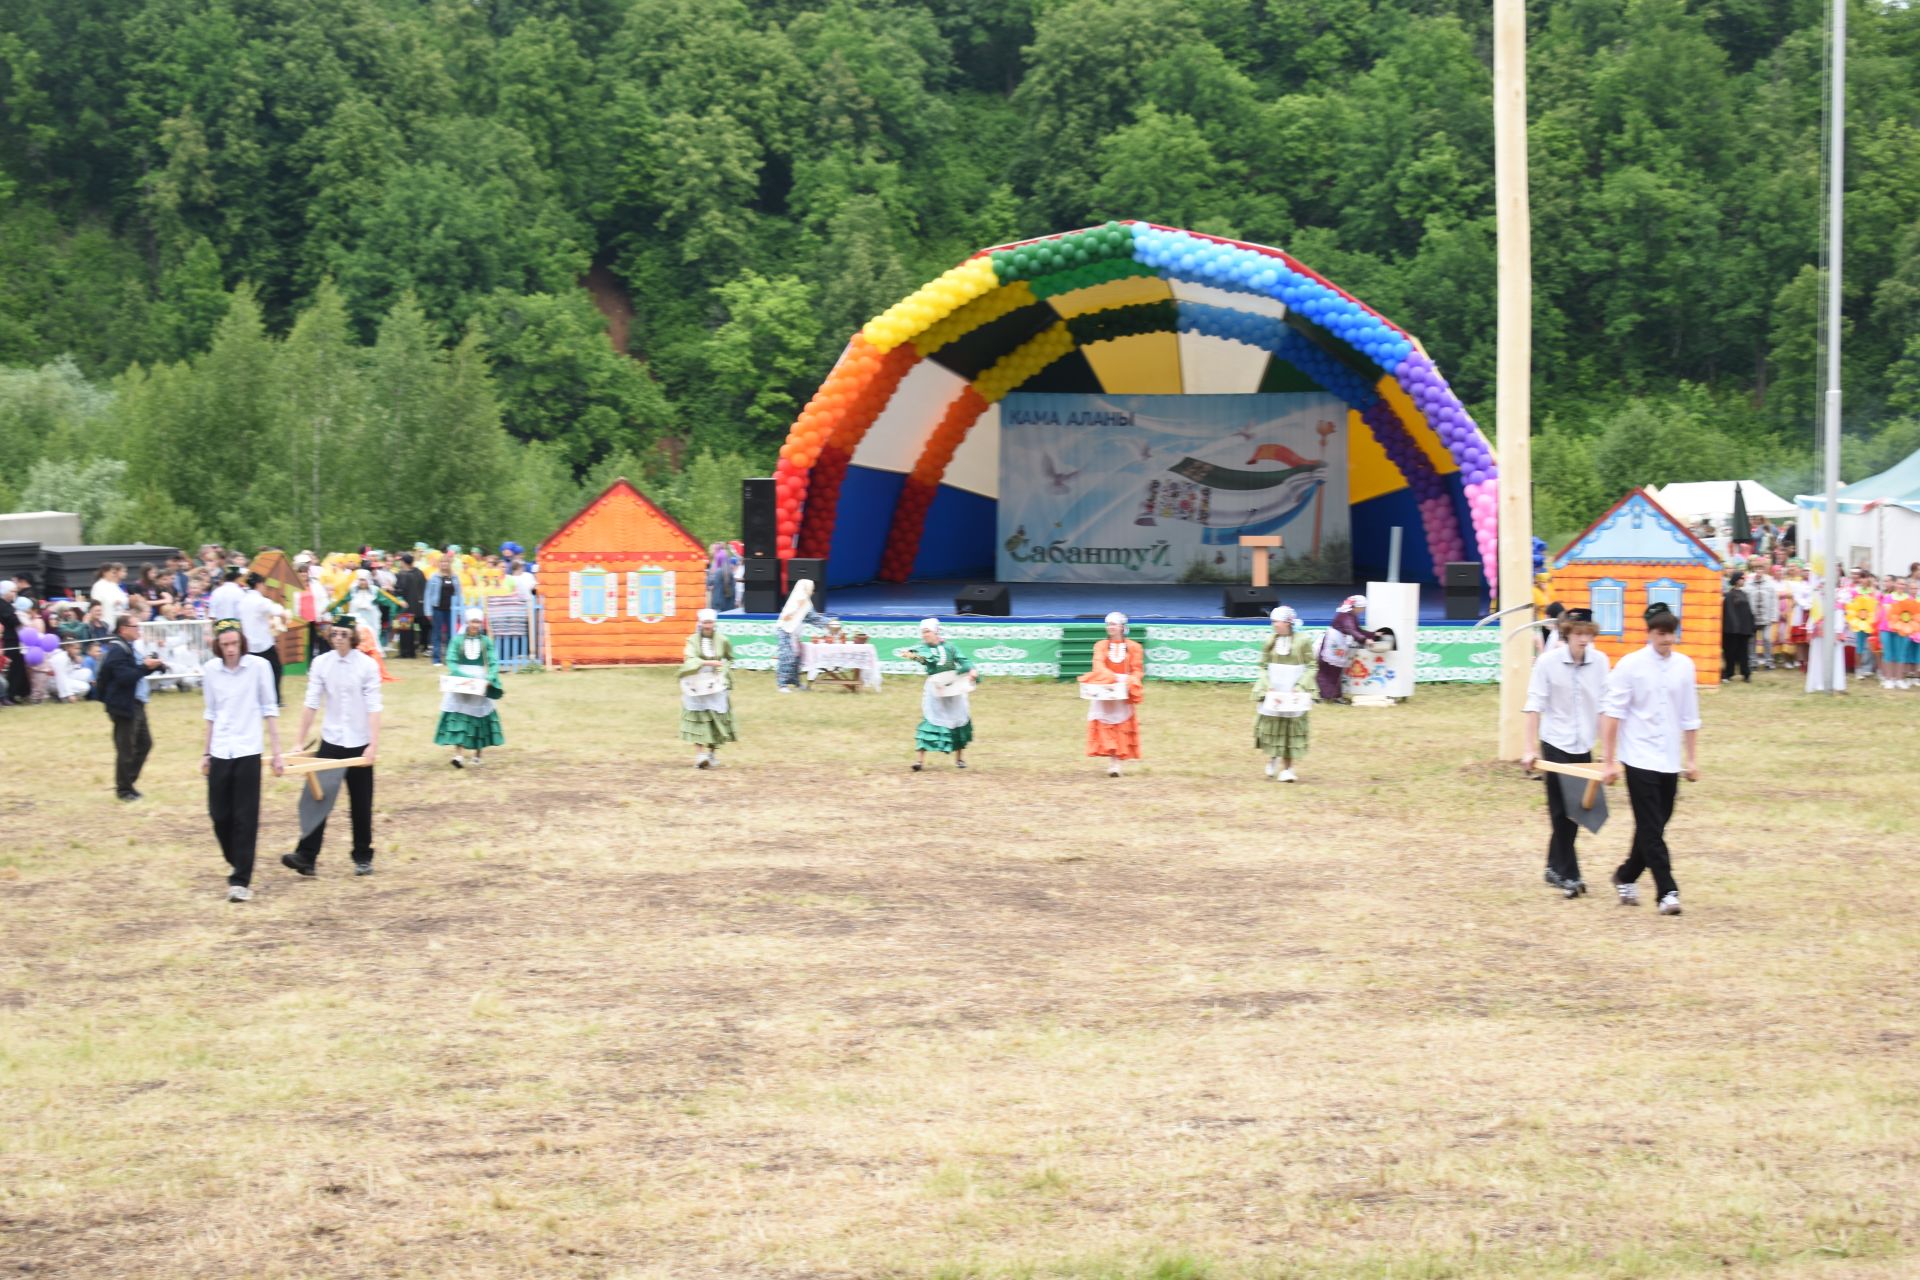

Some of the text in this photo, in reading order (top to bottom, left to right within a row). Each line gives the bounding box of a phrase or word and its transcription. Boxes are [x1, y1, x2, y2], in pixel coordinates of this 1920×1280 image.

[1009, 411, 1135, 427] КАМА АЛАНЫ
[1005, 538, 1173, 571] Сабантуй
